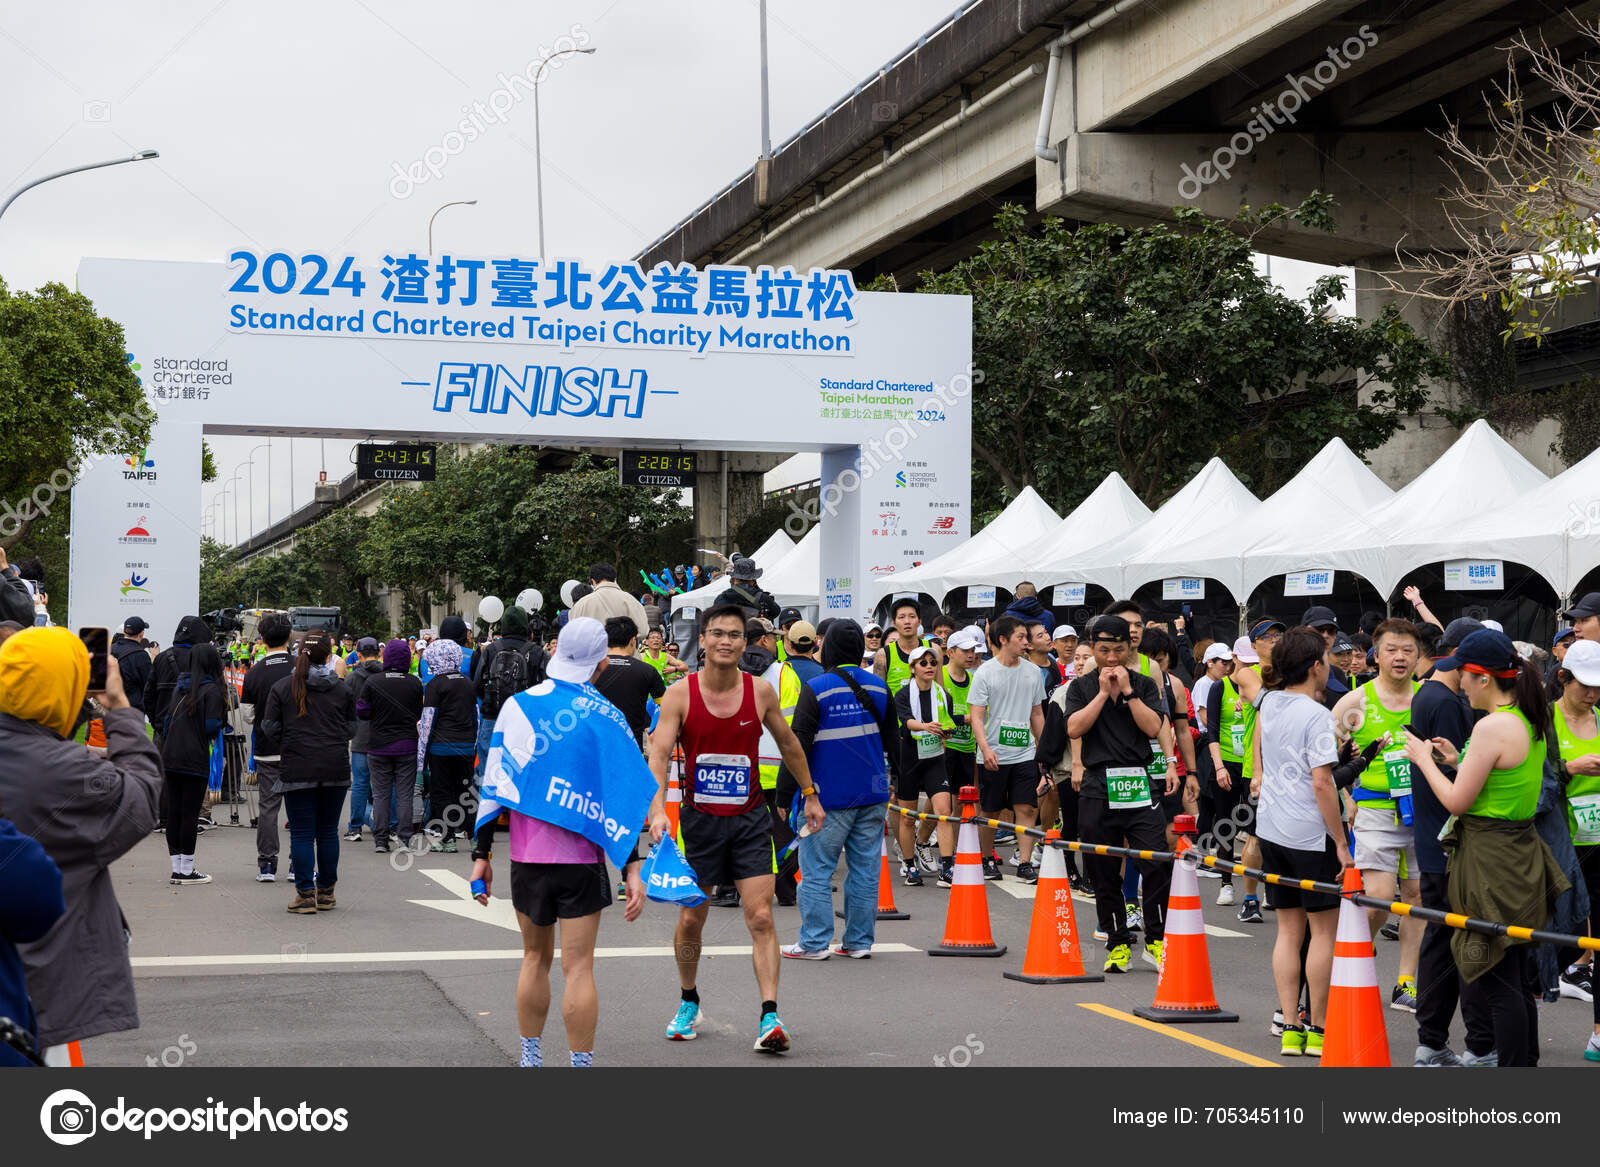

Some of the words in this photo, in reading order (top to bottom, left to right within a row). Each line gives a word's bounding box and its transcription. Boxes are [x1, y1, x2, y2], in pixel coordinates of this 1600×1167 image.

[228, 251, 366, 297] 2024
[380, 254, 854, 322] 渣打臺北公益馬拉松
[230, 304, 364, 333] Standard
[372, 310, 515, 338] Chartered
[522, 316, 606, 347] Taipei
[613, 320, 712, 353] Charity
[719, 324, 850, 351] Marathon
[153, 357, 228, 371] standard
[153, 370, 232, 385] chartered
[433, 362, 648, 419] FINISH
[820, 378, 873, 390] Standard
[876, 380, 933, 392] Chartered
[152, 385, 210, 400] 渣打銀行
[820, 392, 855, 406] Taipei
[857, 394, 914, 405] Marathon
[916, 410, 946, 421] 2024
[374, 450, 430, 464] 2:43:15
[638, 456, 691, 471] 2:28:15
[122, 471, 157, 480] TAIPEI
[374, 469, 420, 479] CITIZEN
[638, 475, 681, 485] CITIZEN
[1002, 730, 1027, 739] 10002
[698, 768, 745, 784] 04576
[1110, 780, 1145, 792] 10644
[650, 872, 698, 889] she
[1054, 888, 1072, 954] 路跑協會
